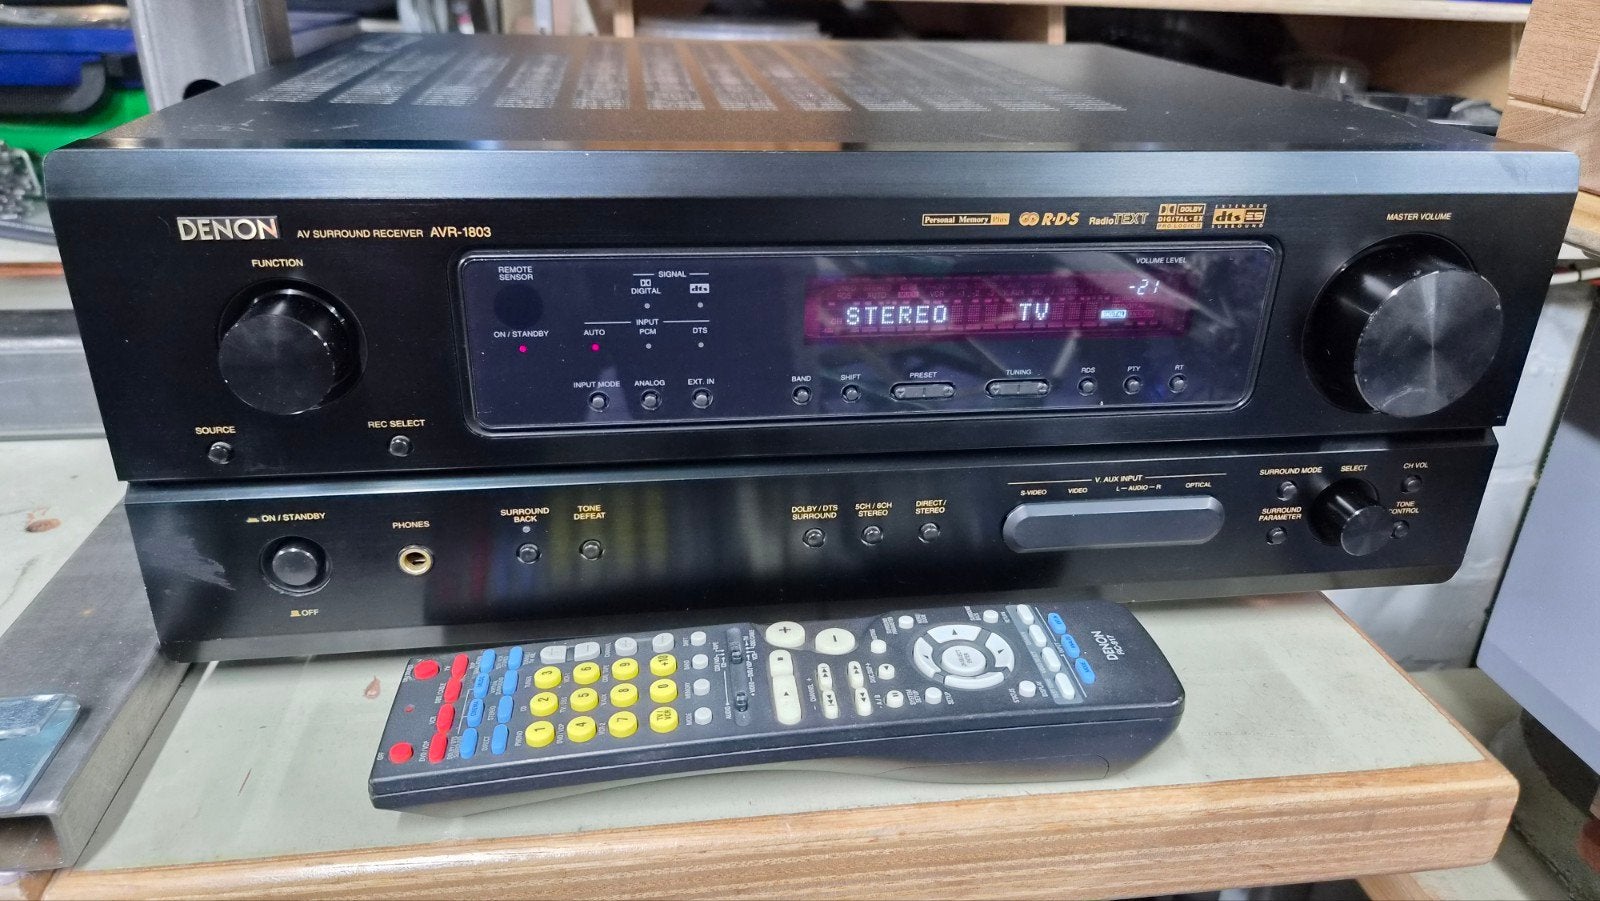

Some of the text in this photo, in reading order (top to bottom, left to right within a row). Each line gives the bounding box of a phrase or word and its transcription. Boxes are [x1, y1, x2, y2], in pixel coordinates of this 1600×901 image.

[924, 216, 956, 224] Personal
[958, 216, 988, 225] Memory
[1215, 210, 1242, 222] dts
[1386, 213, 1419, 221] MASTER
[177, 216, 278, 241] DENON
[430, 226, 492, 238] AVR-1803
[296, 229, 424, 239] AV SURROUND RECEIVER
[251, 258, 304, 268] FUNCTION
[1135, 256, 1187, 264] VOLUME LEVEL
[499, 273, 534, 281] SENSOR
[658, 270, 687, 278] SIGNAL
[630, 287, 661, 295] DIGITAL
[1128, 279, 1160, 295] -21
[846, 305, 948, 326] STEREO
[1019, 303, 1049, 321] TV
[635, 318, 660, 326] INPUT
[512, 330, 549, 338] STANDBY
[1005, 368, 1032, 376] TUNING
[1080, 366, 1096, 374] RDS
[840, 373, 862, 381] SHIFT
[909, 371, 938, 379] PRESET
[597, 380, 621, 388] MODE
[634, 379, 666, 387] ANALOG
[687, 378, 705, 386] EXT.
[367, 419, 426, 429] REC SELECT
[195, 425, 236, 435] SOURCE
[1259, 466, 1323, 476] SURROUND MODE
[1340, 464, 1368, 473] SELECT
[1103, 475, 1119, 483] AUX
[1120, 474, 1144, 482] INPUT
[1185, 481, 1212, 489] OPTICAL
[1068, 487, 1089, 495] VIDEO
[577, 504, 602, 512] TONE
[791, 505, 817, 513] DOLBY
[854, 502, 870, 510] 5CH
[1261, 506, 1302, 515] SURROUND
[500, 507, 550, 517] SURROUND
[573, 511, 606, 520] DEFEAT
[857, 509, 889, 518] STEREO
[915, 507, 946, 515] STEREO
[261, 514, 276, 522] ON
[282, 512, 326, 521] STANDBY
[513, 515, 538, 523] BACK
[792, 512, 837, 520] SURROUND
[1258, 513, 1302, 522] PARAMETER
[392, 520, 430, 529] PHONES
[301, 609, 319, 617] OFF
[1090, 630, 1119, 662] DENON
[1105, 634, 1126, 656] RC-917
[657, 655, 669, 666] +10
[664, 709, 672, 720] VCR
[685, 712, 693, 726] MODE
